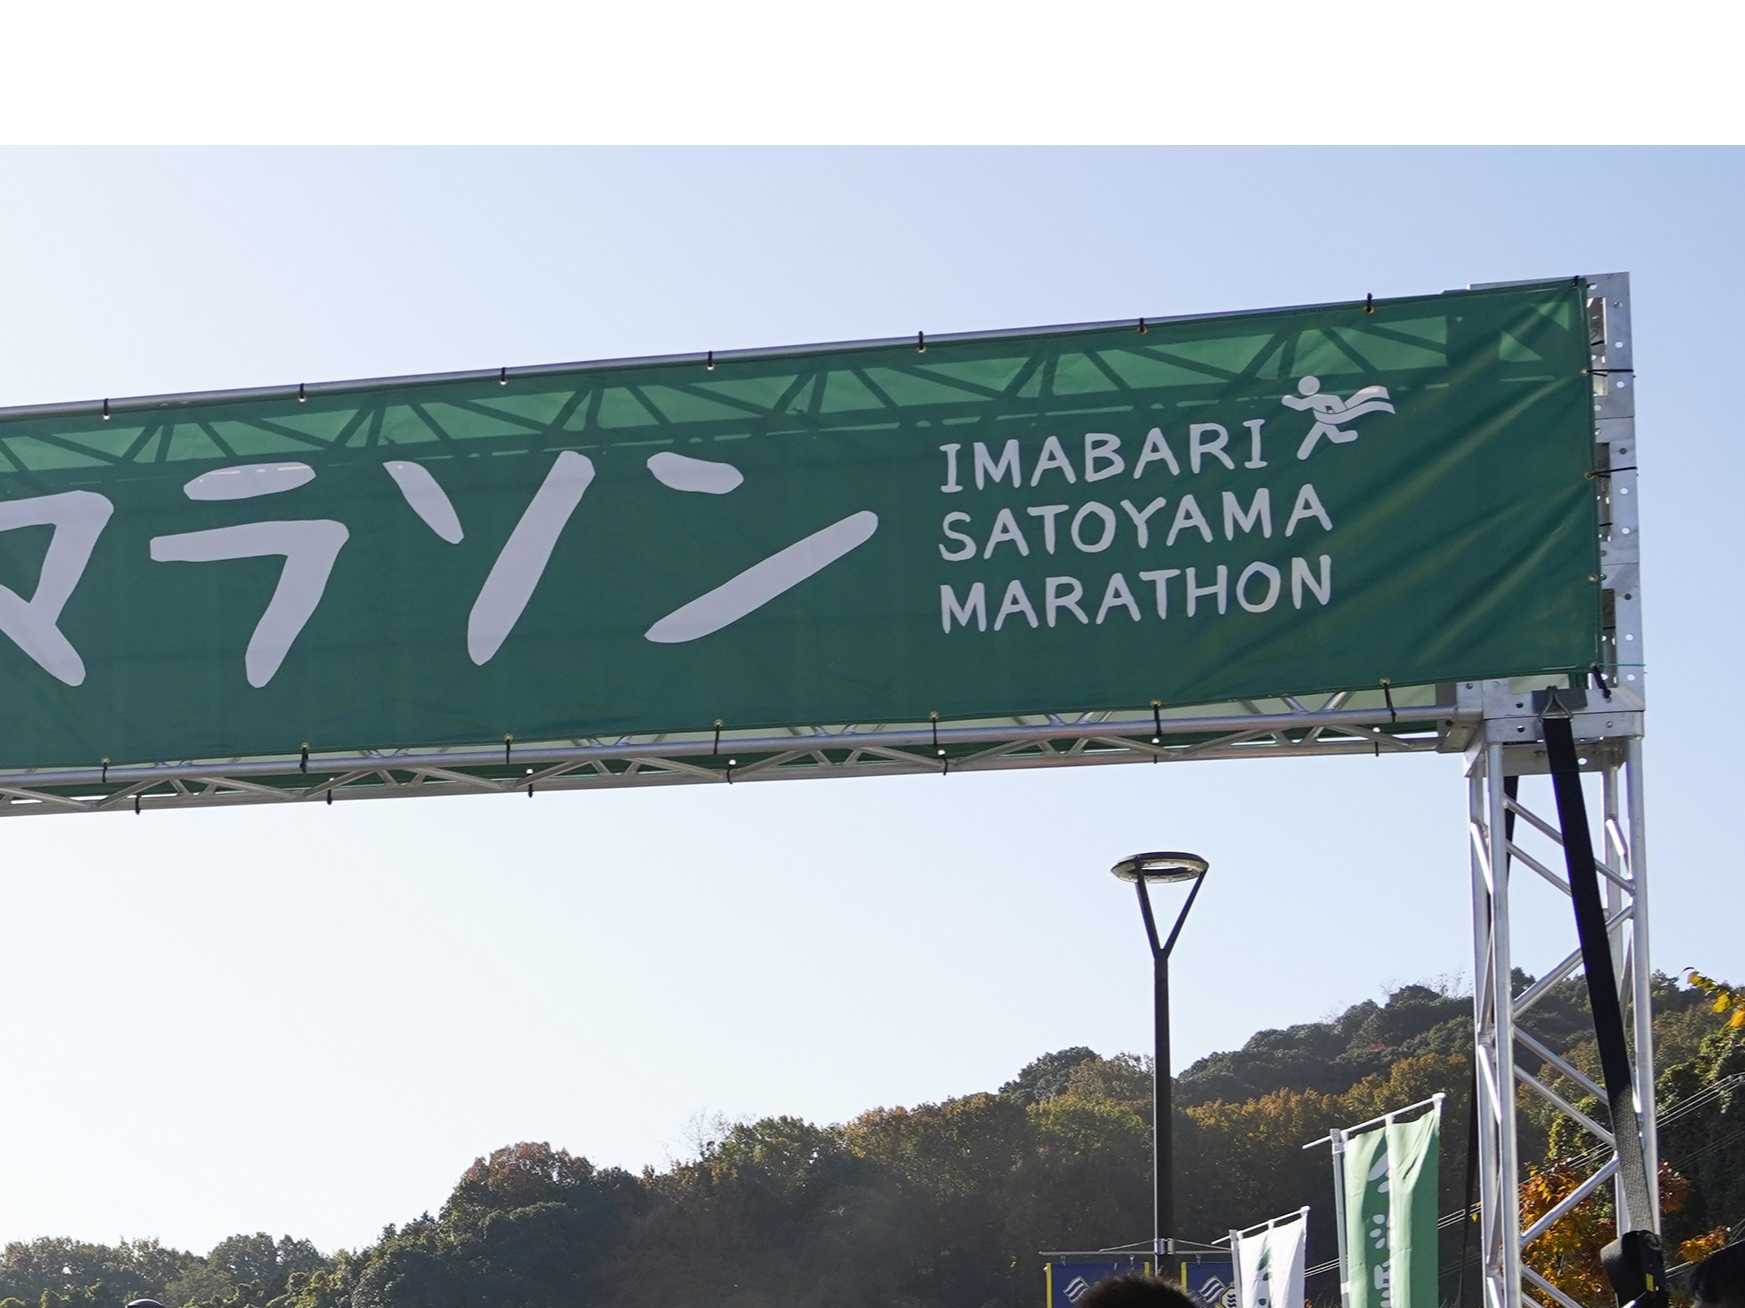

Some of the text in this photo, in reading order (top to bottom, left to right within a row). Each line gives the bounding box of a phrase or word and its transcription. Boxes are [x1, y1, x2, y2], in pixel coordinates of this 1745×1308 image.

[940, 419, 1267, 494] IMABARI
[939, 484, 1333, 562] SATOYAMA
[940, 554, 1333, 634] MARATHON
